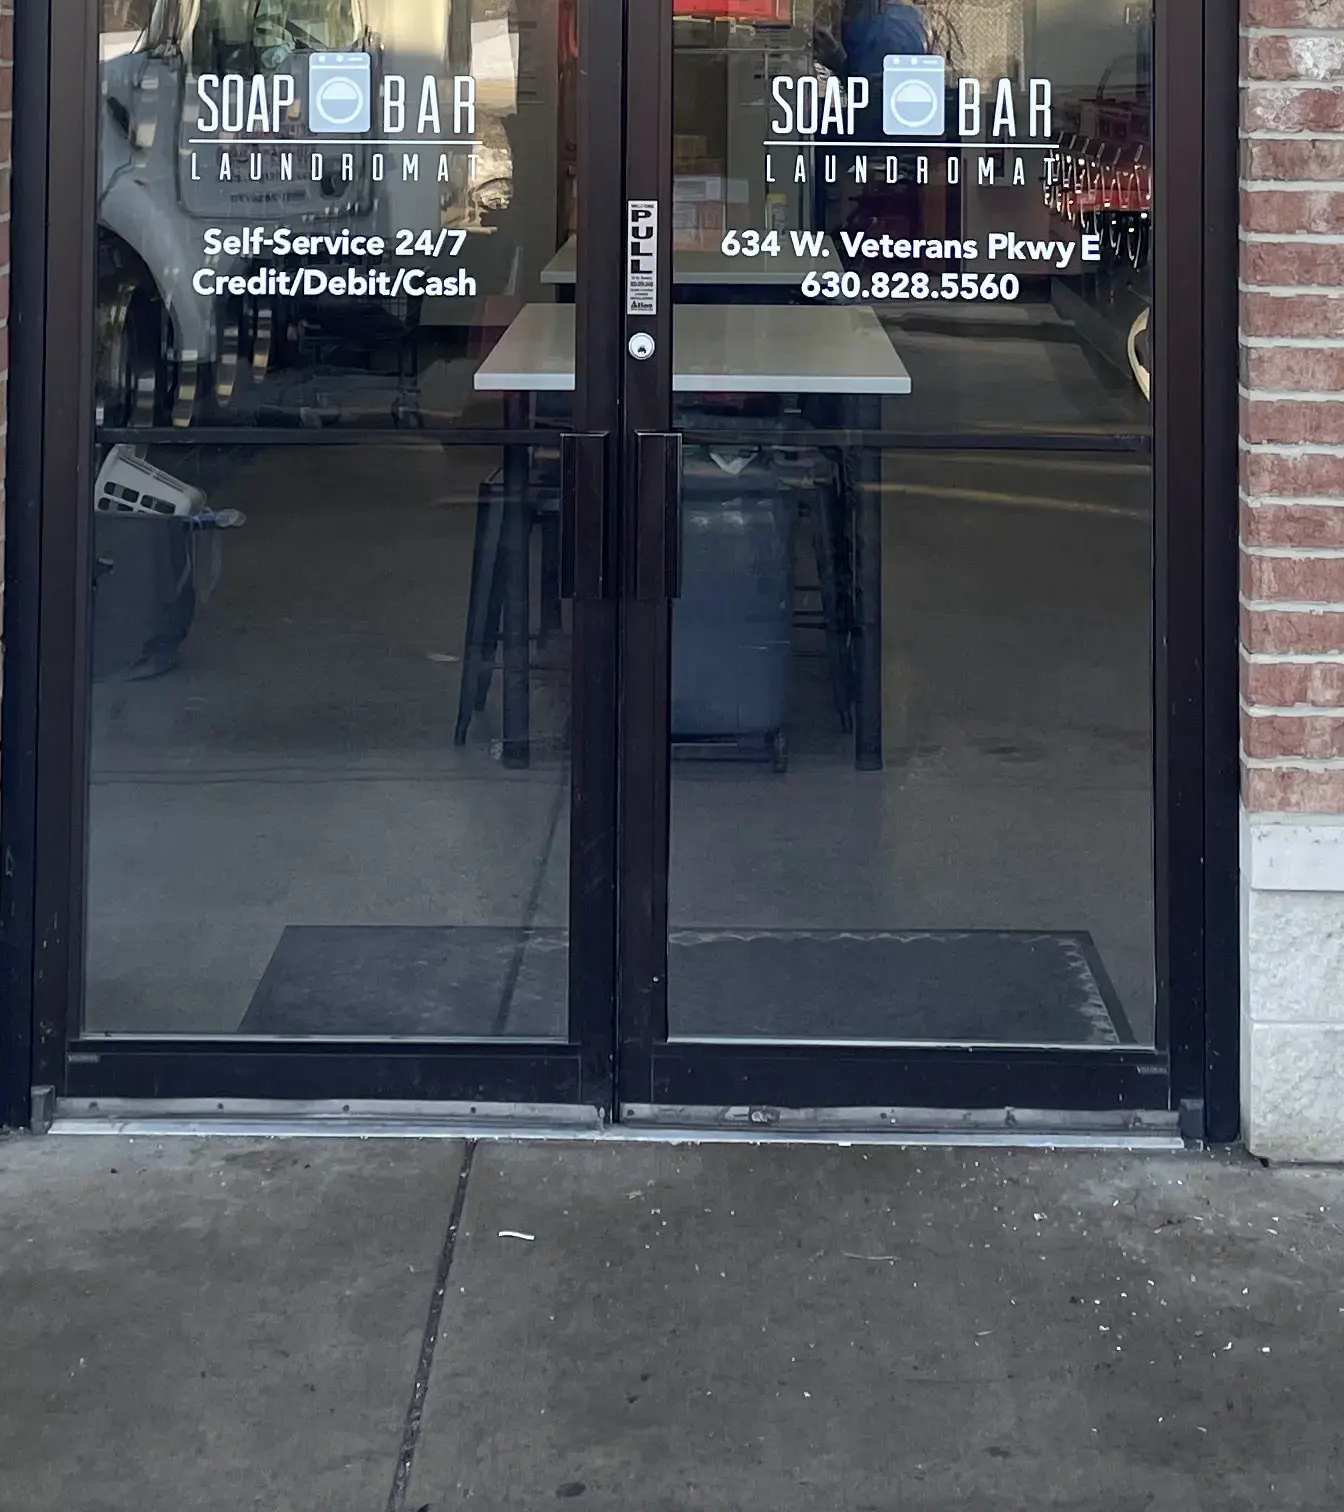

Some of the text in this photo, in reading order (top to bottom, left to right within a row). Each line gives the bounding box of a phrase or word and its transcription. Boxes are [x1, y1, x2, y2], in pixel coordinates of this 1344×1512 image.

[197, 74, 475, 134] SOAP BAR
[771, 75, 1051, 137] SOAP BAR
[191, 152, 481, 182] LAUNDROMAT
[767, 154, 1058, 185] LAUNDROMAT
[203, 228, 467, 257] Self-Service 24/7
[631, 210, 653, 274] PULL
[721, 230, 1100, 268] 634 W. Veterans Pkwy E
[192, 268, 477, 297] Credit/Debit/Cash
[800, 271, 1019, 300] 630.828.5560
